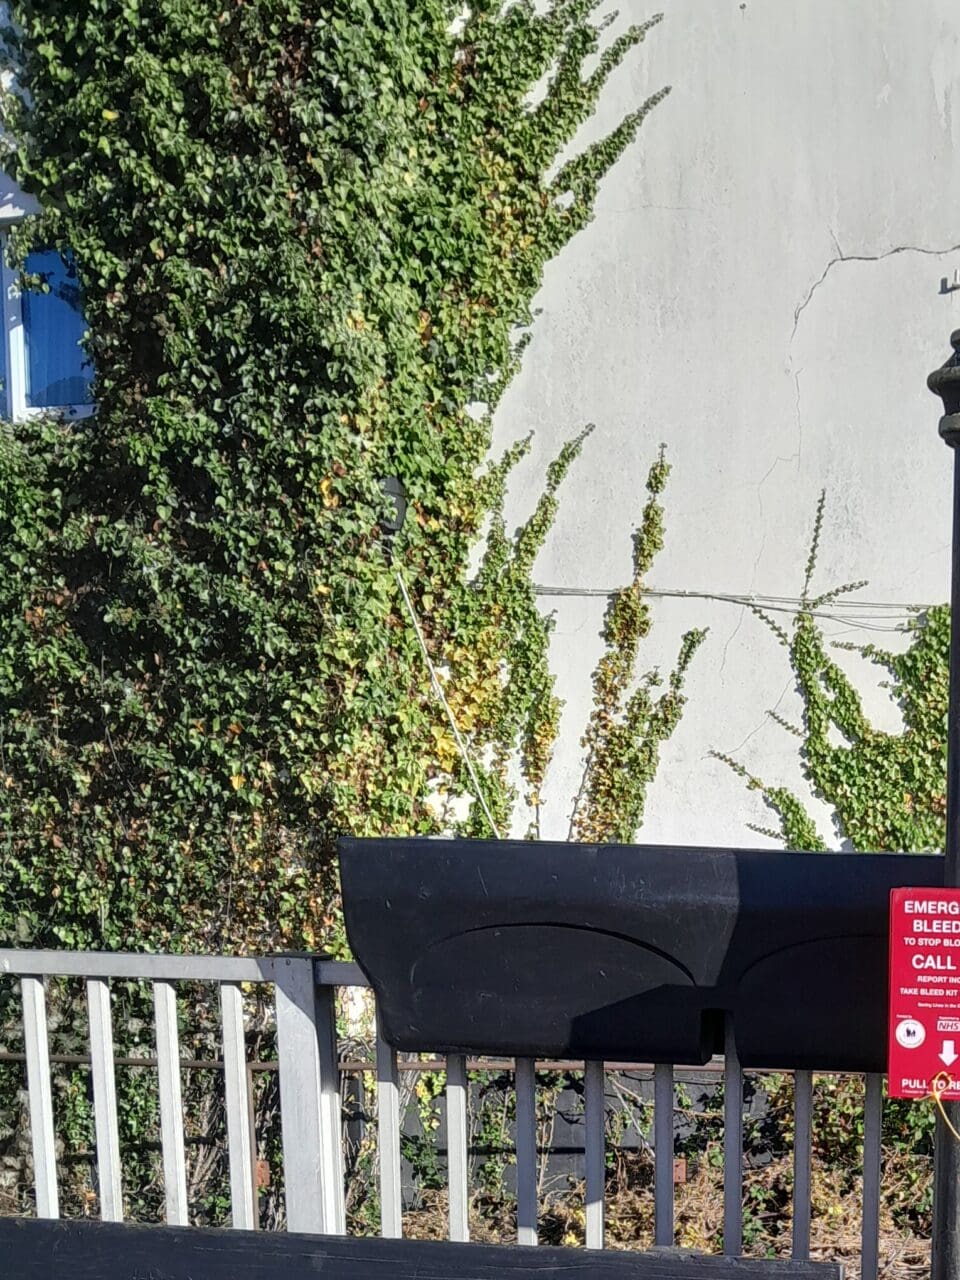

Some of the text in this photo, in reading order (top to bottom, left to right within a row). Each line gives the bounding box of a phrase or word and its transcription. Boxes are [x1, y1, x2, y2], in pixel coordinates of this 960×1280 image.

[904, 937, 916, 946] TO
[918, 938, 941, 946] STOP
[912, 954, 956, 970] CALL
[920, 988, 944, 996] BLEED
[938, 1022, 959, 1030] NHS
[902, 1079, 928, 1089] PULL
